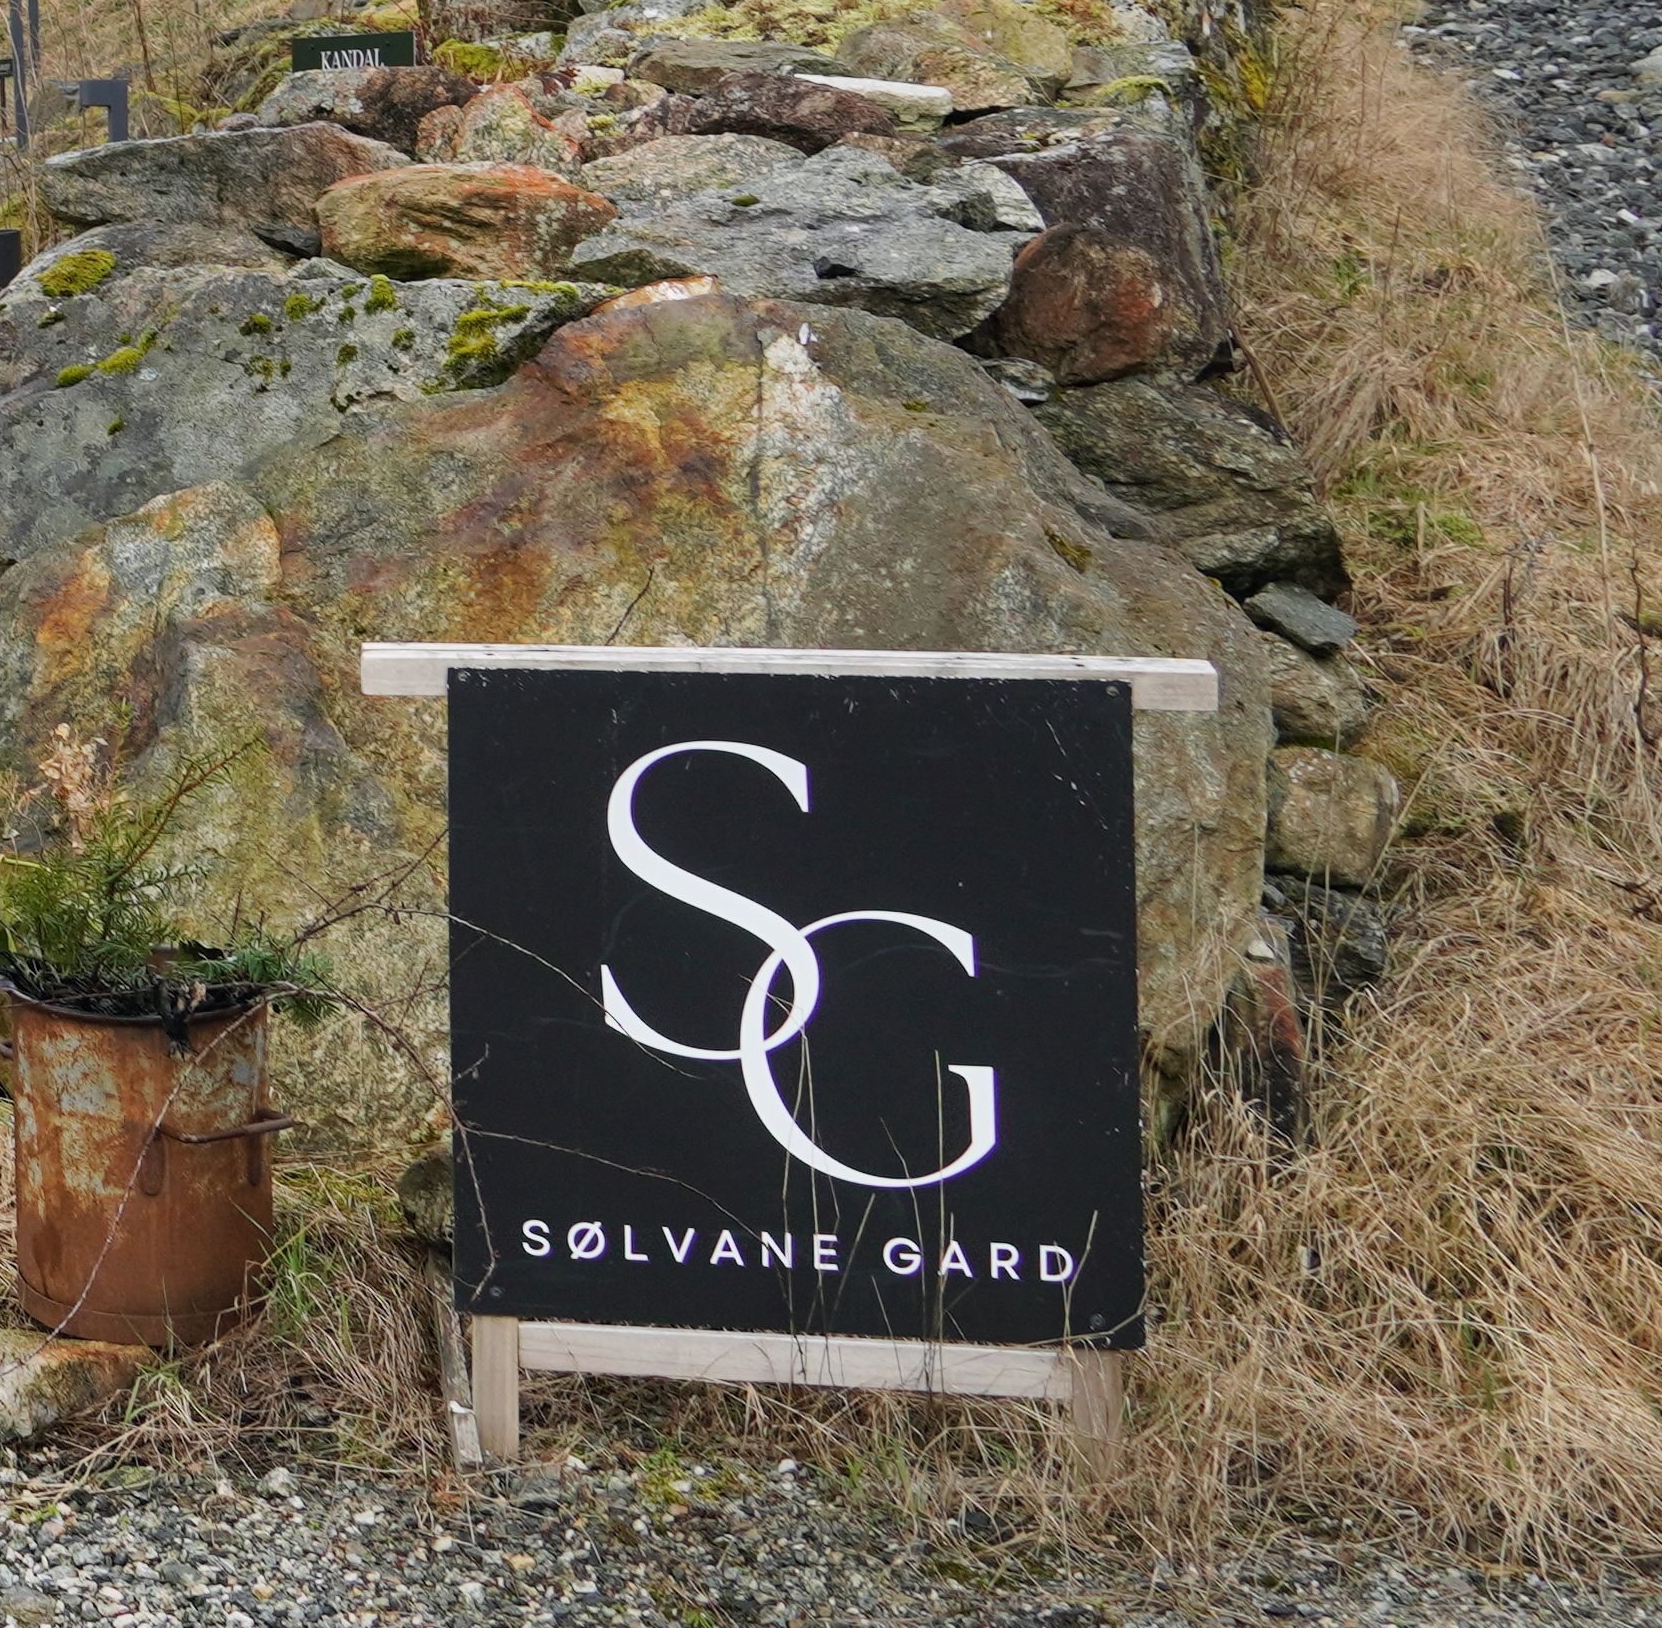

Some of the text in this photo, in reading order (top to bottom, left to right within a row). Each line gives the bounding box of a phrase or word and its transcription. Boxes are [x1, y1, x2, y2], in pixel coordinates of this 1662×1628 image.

[320, 48, 385, 71] KANDAL
[601, 740, 997, 1188] SG
[521, 1218, 1077, 1283] SØLVANE GARD
